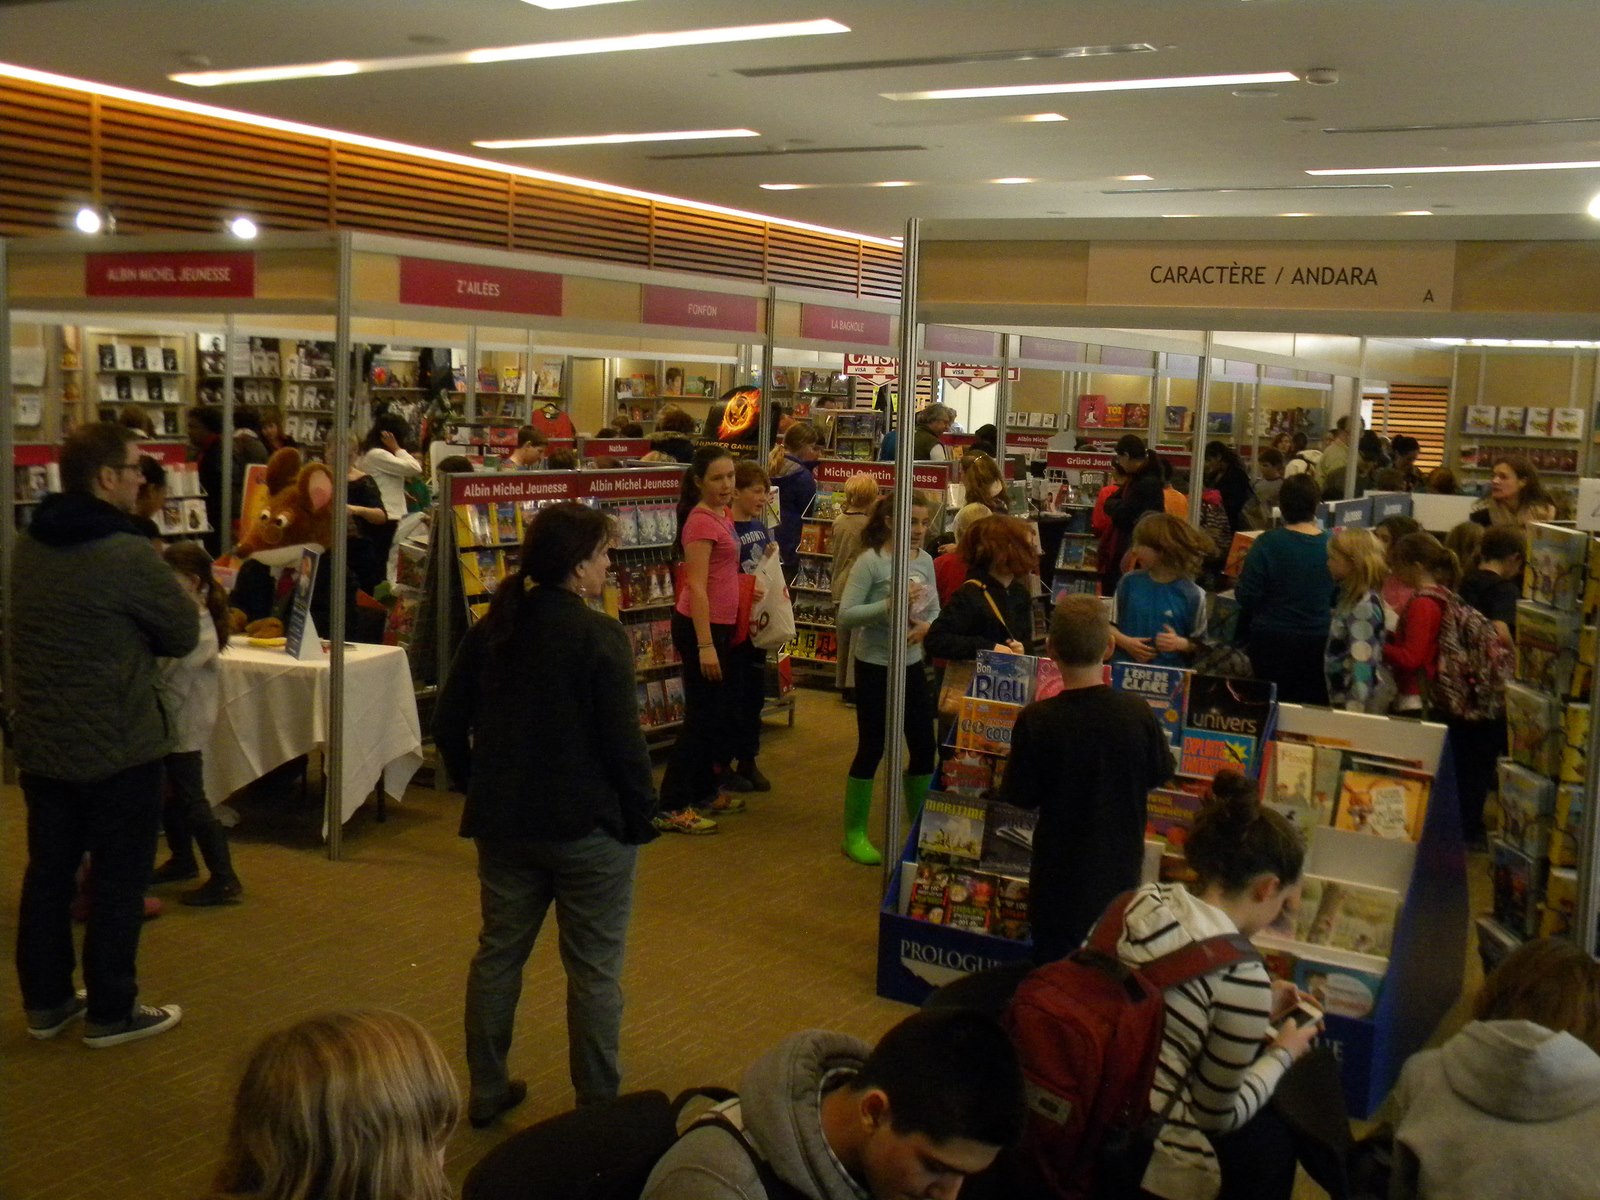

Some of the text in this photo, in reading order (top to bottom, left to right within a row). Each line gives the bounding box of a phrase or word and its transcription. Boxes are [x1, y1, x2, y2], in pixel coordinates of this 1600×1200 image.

[106, 267, 231, 281] ALBIN MICHEL JEUNESSE
[1150, 261, 1267, 285] CARACTÈRE
[1290, 266, 1378, 286] ANDARA
[456, 279, 500, 297] Z'AILÉES
[1423, 289, 1435, 303] A
[687, 303, 717, 317] FONFON
[831, 319, 865, 333] LA BAGNOLE
[608, 445, 628, 453] Nathan
[1066, 457, 1112, 467] Gründ Jeun
[824, 466, 854, 478] Michel
[464, 482, 568, 498] Albin Michel Jeunesse
[589, 478, 679, 492] Albin Michel Jeunesse
[976, 662, 992, 673] Bon
[1193, 711, 1258, 734] univers
[900, 938, 1002, 973] PROLOGU
